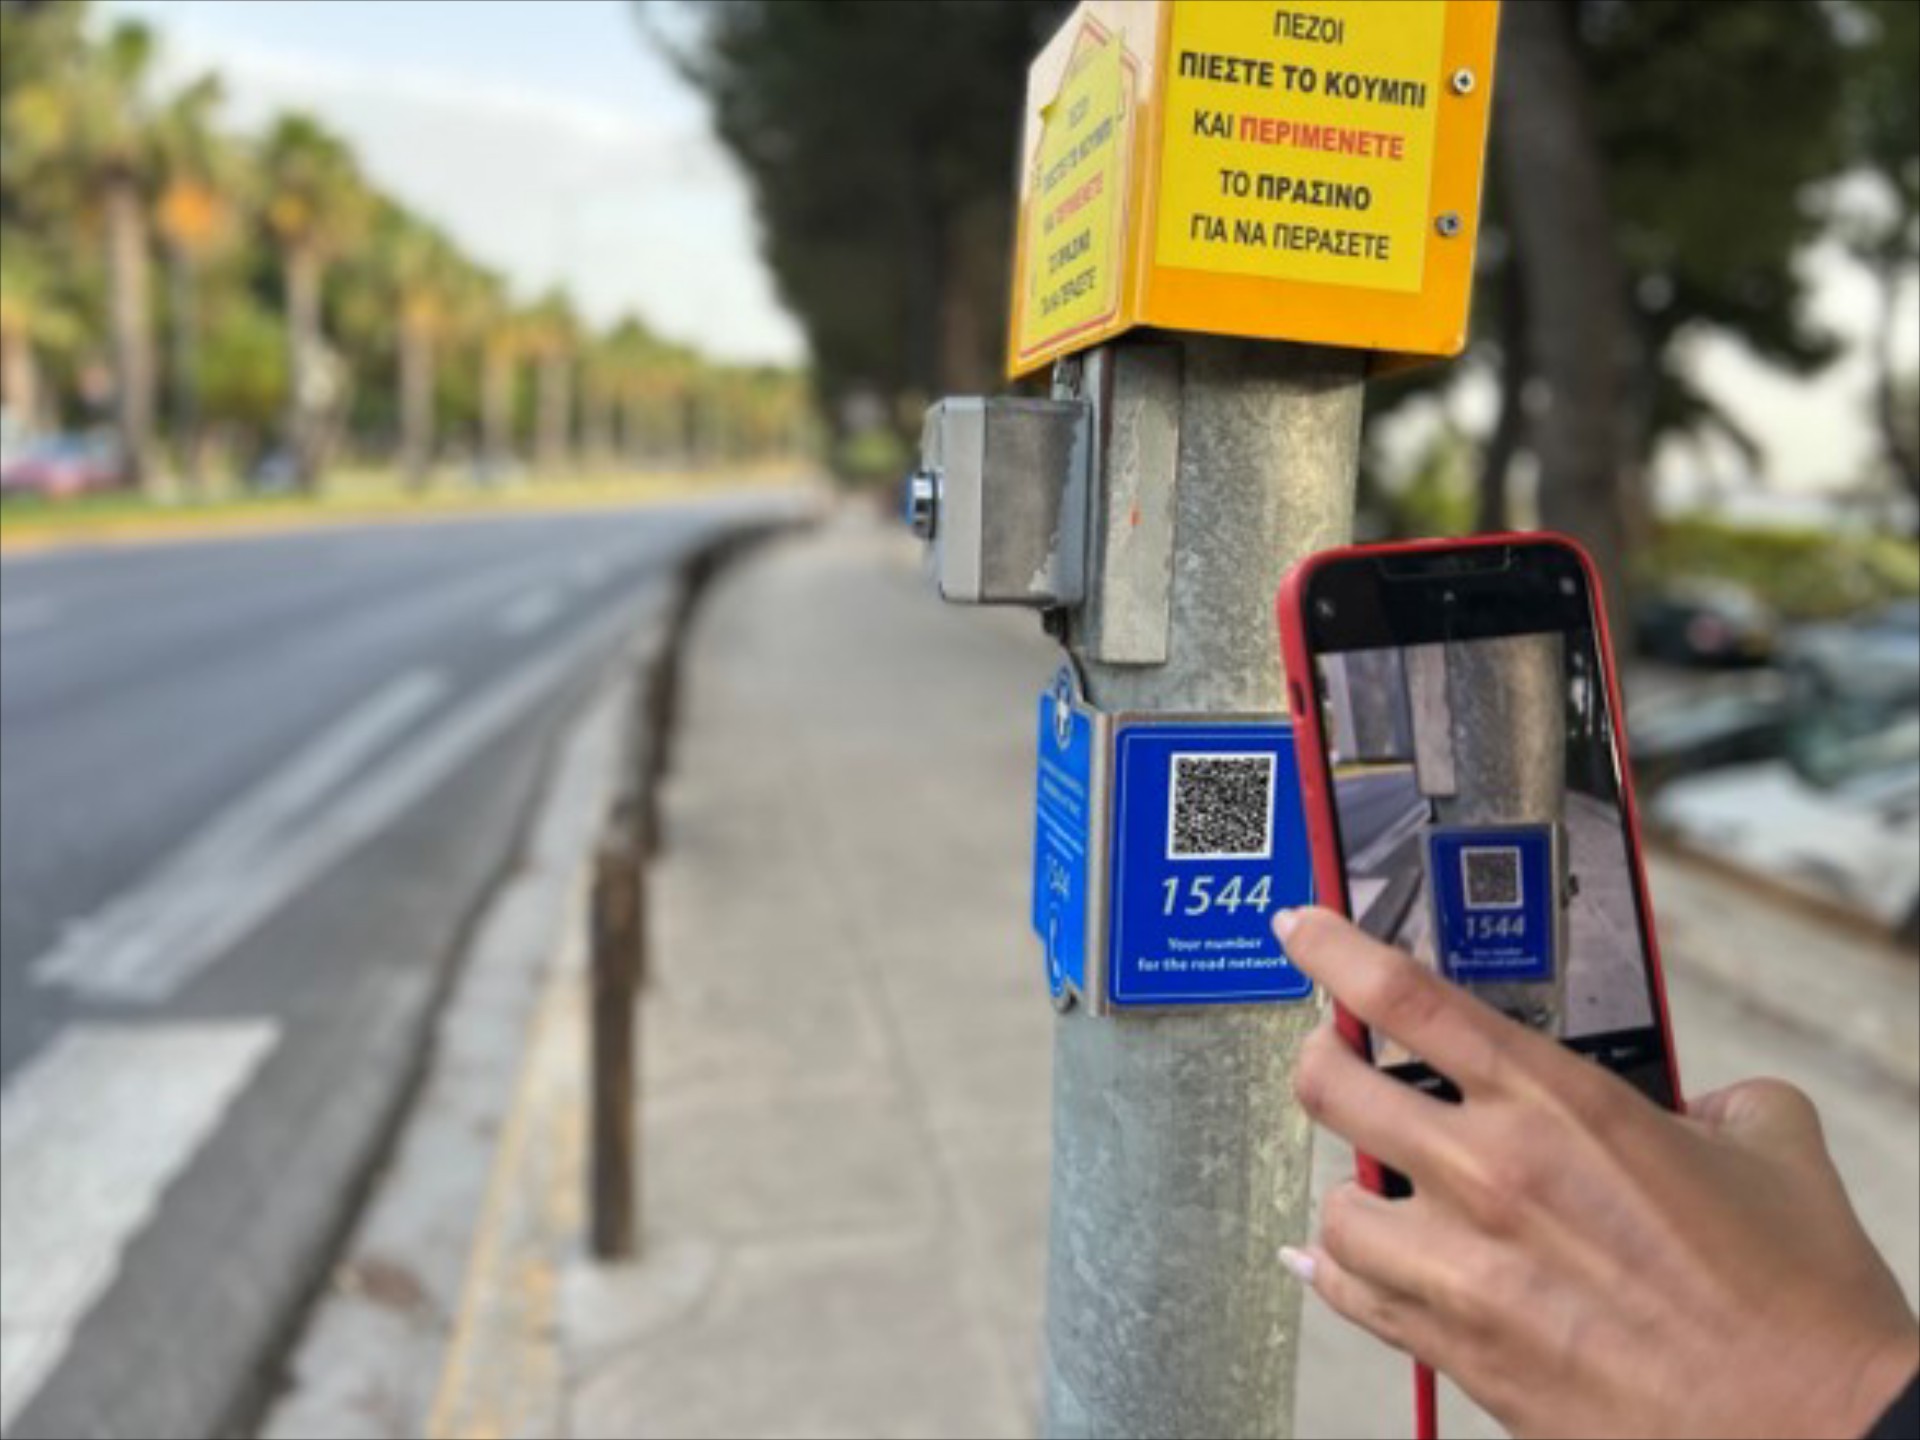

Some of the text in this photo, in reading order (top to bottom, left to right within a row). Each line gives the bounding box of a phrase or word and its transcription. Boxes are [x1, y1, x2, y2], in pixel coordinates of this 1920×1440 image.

[1273, 10, 1344, 44] ΠΕΖΟΙ
[1179, 51, 1426, 108] ΠΙΕΣΤΕ ΤΟ ΚΟΥΜΠΙ
[1194, 110, 1405, 160] ΚΑΙ ΠΕΡΙΜΕΝΕΤΕ
[1220, 170, 1371, 211] ΤΟ ΠΡΑΣΙΝΟ
[1190, 214, 1390, 260] ΓΙΑ ΝΑ ΠΕΡΑΣΕΤΕ
[1161, 875, 1272, 916] 1544
[1168, 937, 1262, 951] Your number
[1466, 915, 1525, 939] 1544
[1138, 955, 1289, 971] for the road network
